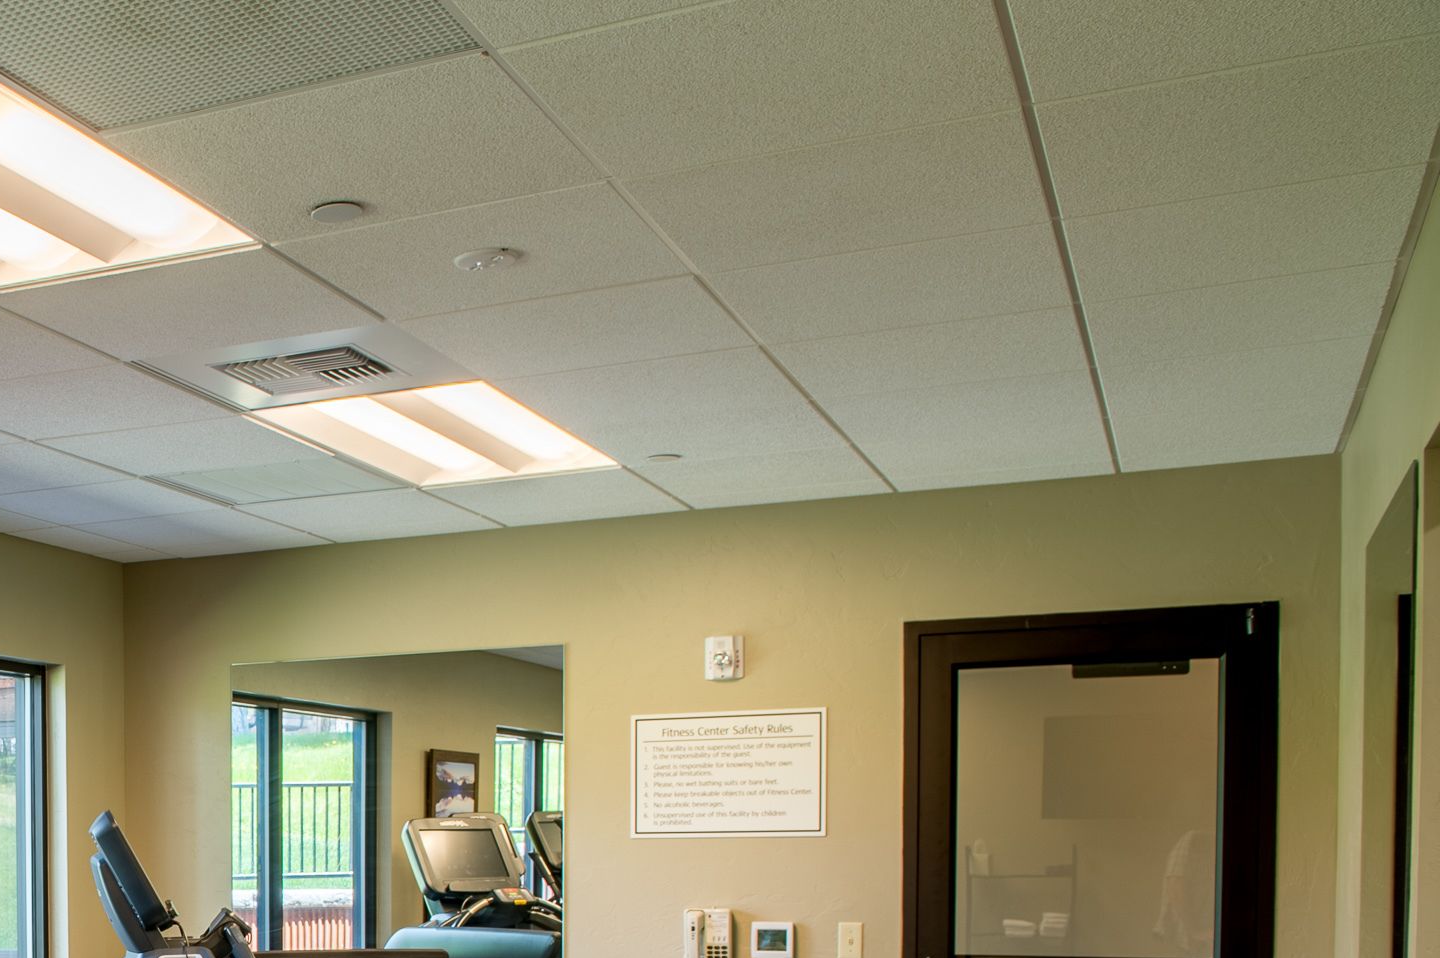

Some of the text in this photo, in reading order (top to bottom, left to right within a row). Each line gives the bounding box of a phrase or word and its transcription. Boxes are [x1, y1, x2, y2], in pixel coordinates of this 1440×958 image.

[662, 724, 794, 737] Fitness Center Safety Rules
[776, 742, 812, 750] equipment
[671, 751, 712, 760] responsibility
[679, 762, 714, 770] responsible
[728, 810, 750, 818] facility
